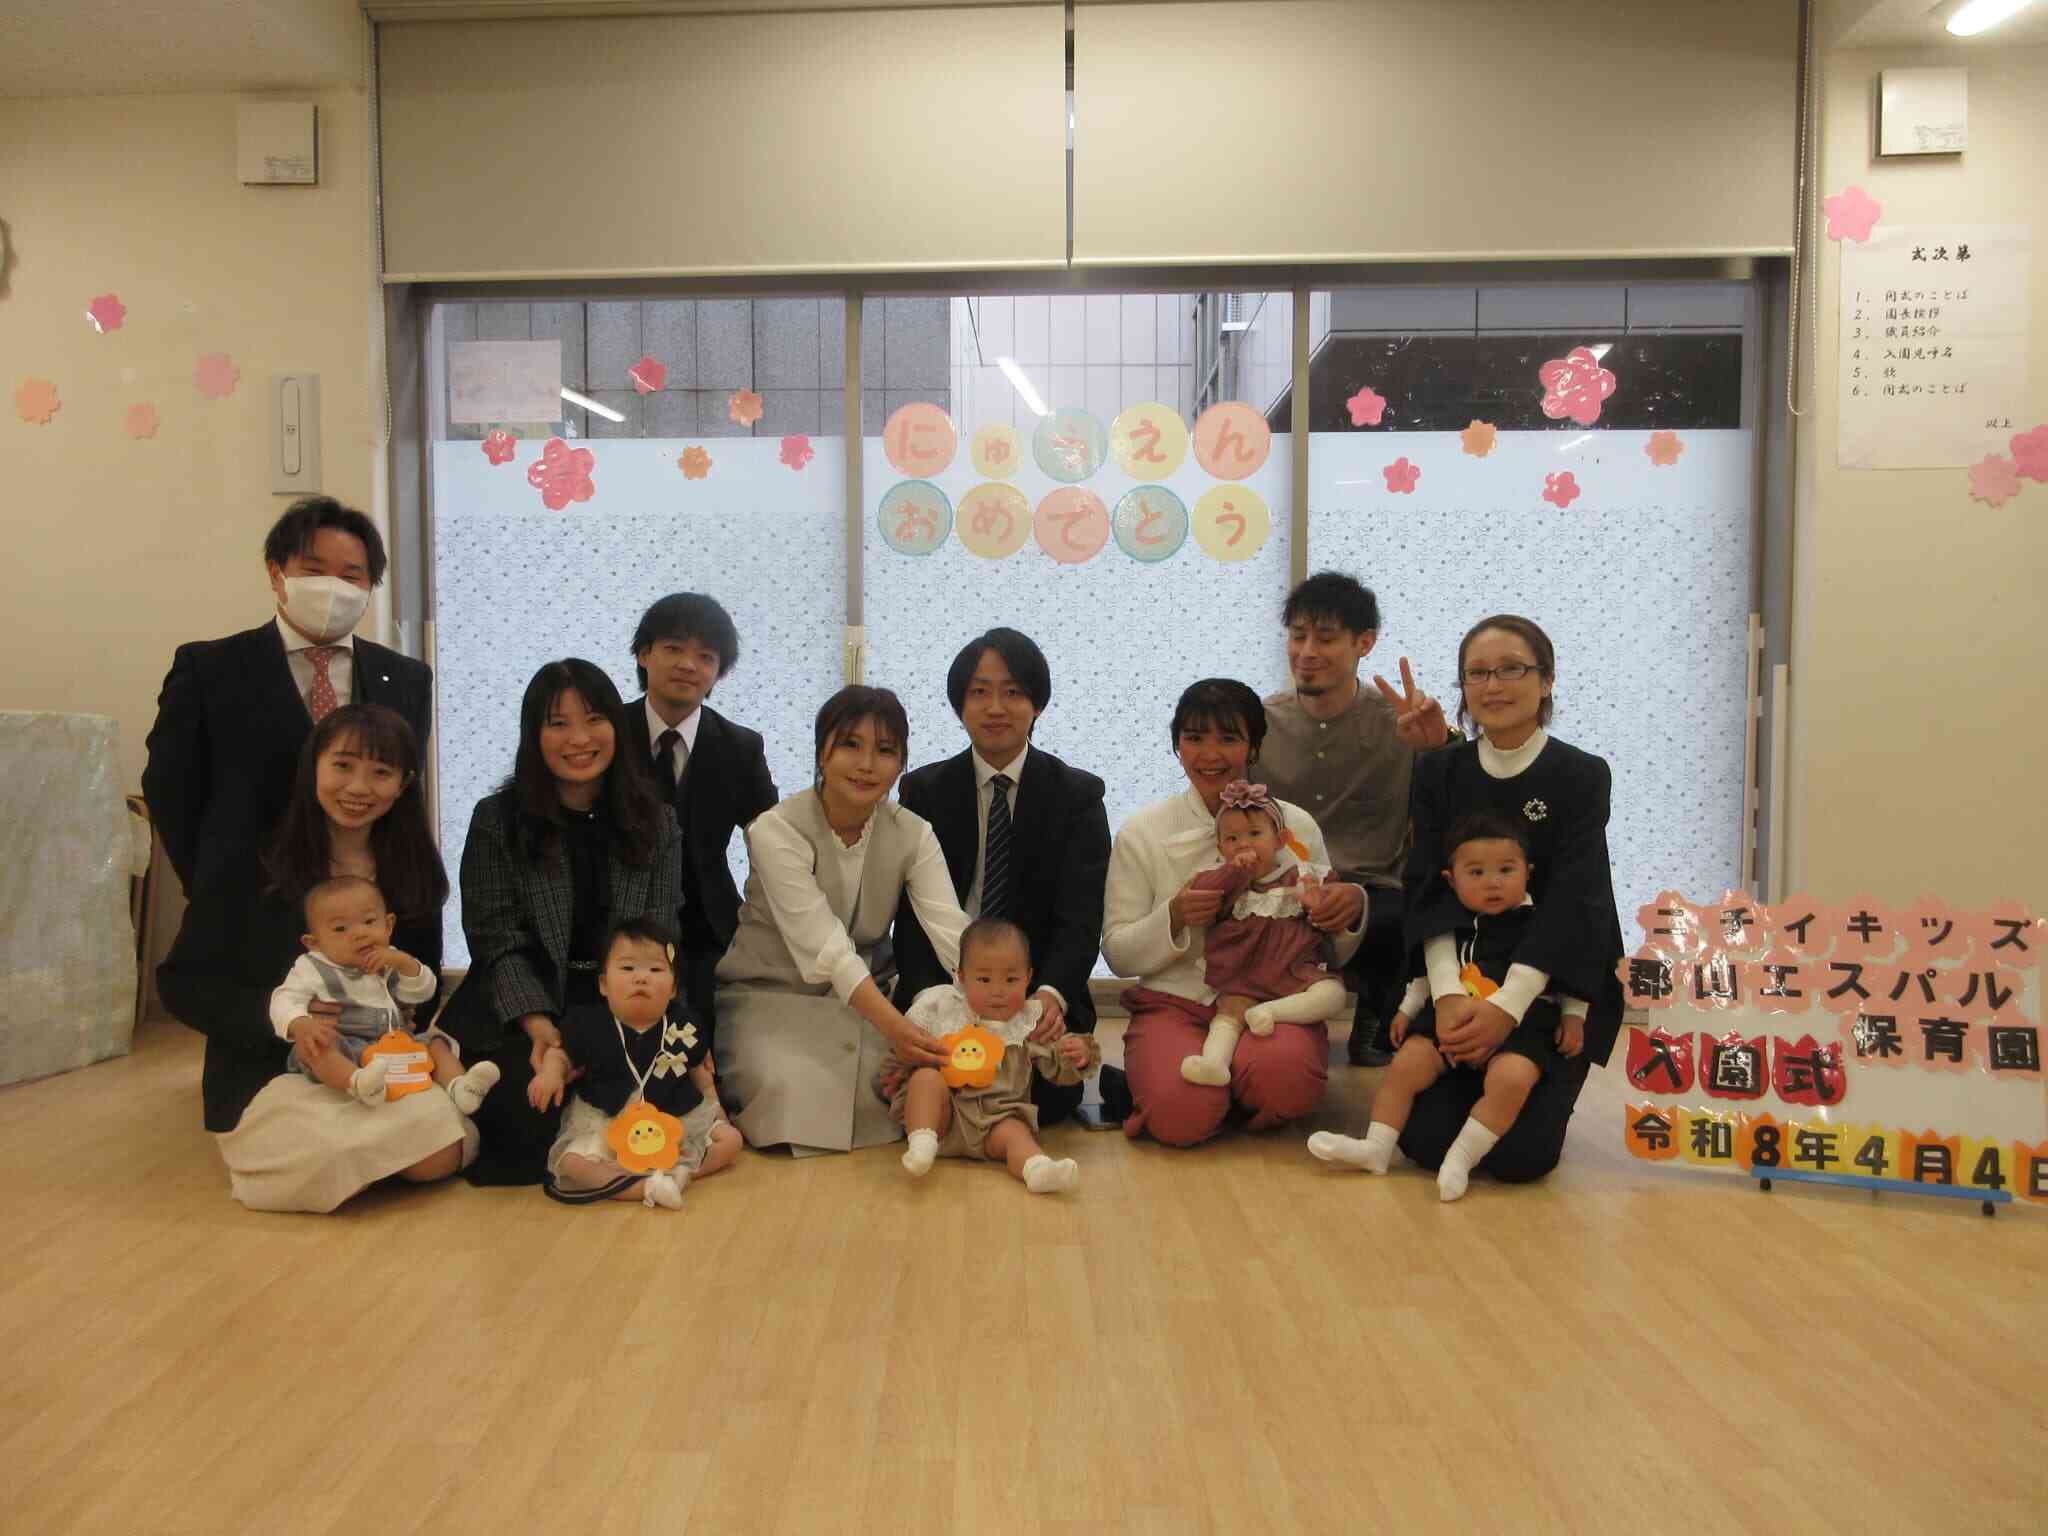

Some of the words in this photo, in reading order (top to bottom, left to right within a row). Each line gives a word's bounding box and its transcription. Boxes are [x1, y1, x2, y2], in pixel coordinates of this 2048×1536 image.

[1911, 245, 1972, 262] 式次第
[1985, 417, 2014, 429] 以上
[895, 500, 1246, 551] おめでとう
[1628, 958, 2013, 1010] 郡山エスパル
[1852, 1014, 2040, 1072] 保育園
[1634, 1038, 1836, 1100] 入園式
